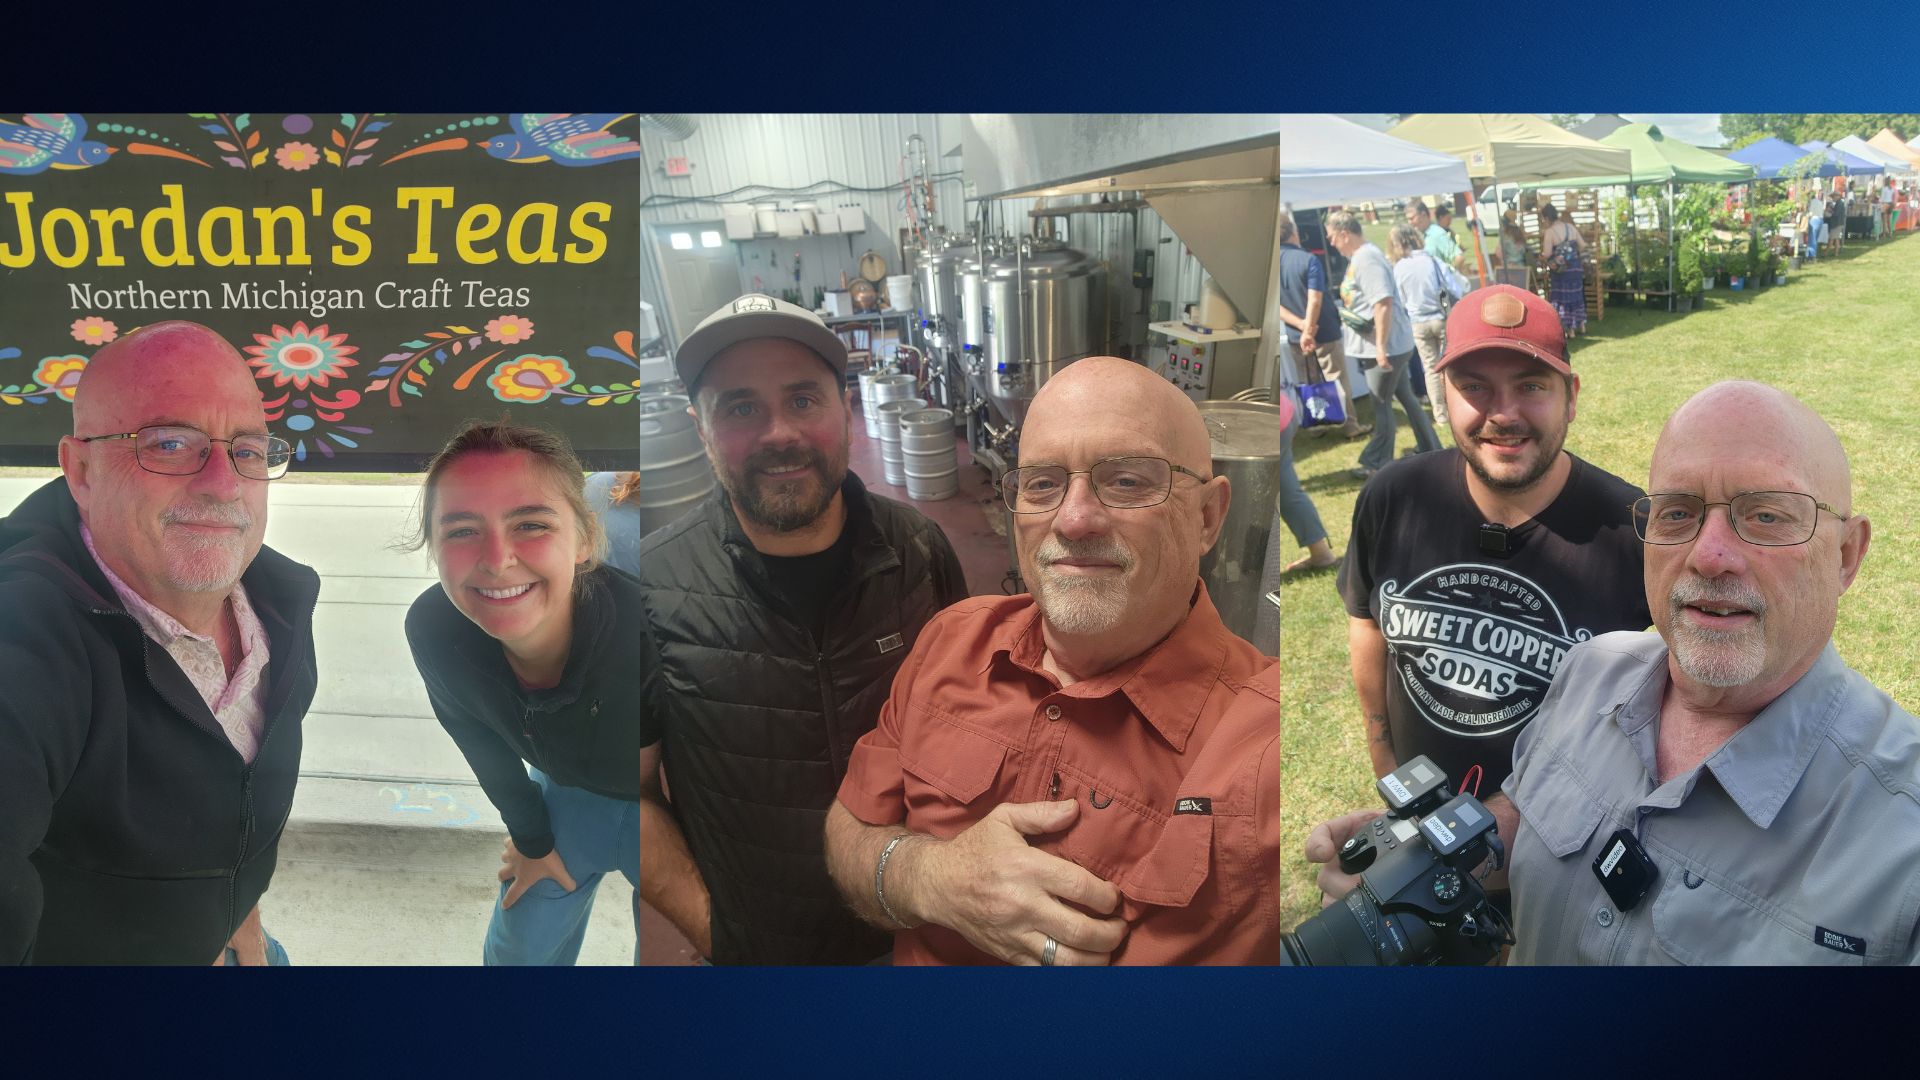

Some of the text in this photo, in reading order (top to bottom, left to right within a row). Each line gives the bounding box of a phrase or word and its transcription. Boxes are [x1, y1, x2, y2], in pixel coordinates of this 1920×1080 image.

[0, 184, 612, 268] Jordan's Teas
[67, 278, 530, 318] Northern Michigan Craft Teas
[1437, 572, 1542, 612] HANDCRAFTED
[1386, 603, 1567, 675] SWEET COPPER
[1404, 663, 1434, 706] MICHIGAN
[1430, 699, 1456, 721] MADE
[1422, 652, 1513, 696] SODAS
[1603, 844, 1623, 872] dwvideo
[1823, 937, 1844, 949] BAUER
[1824, 931, 1843, 943] EDDIE
